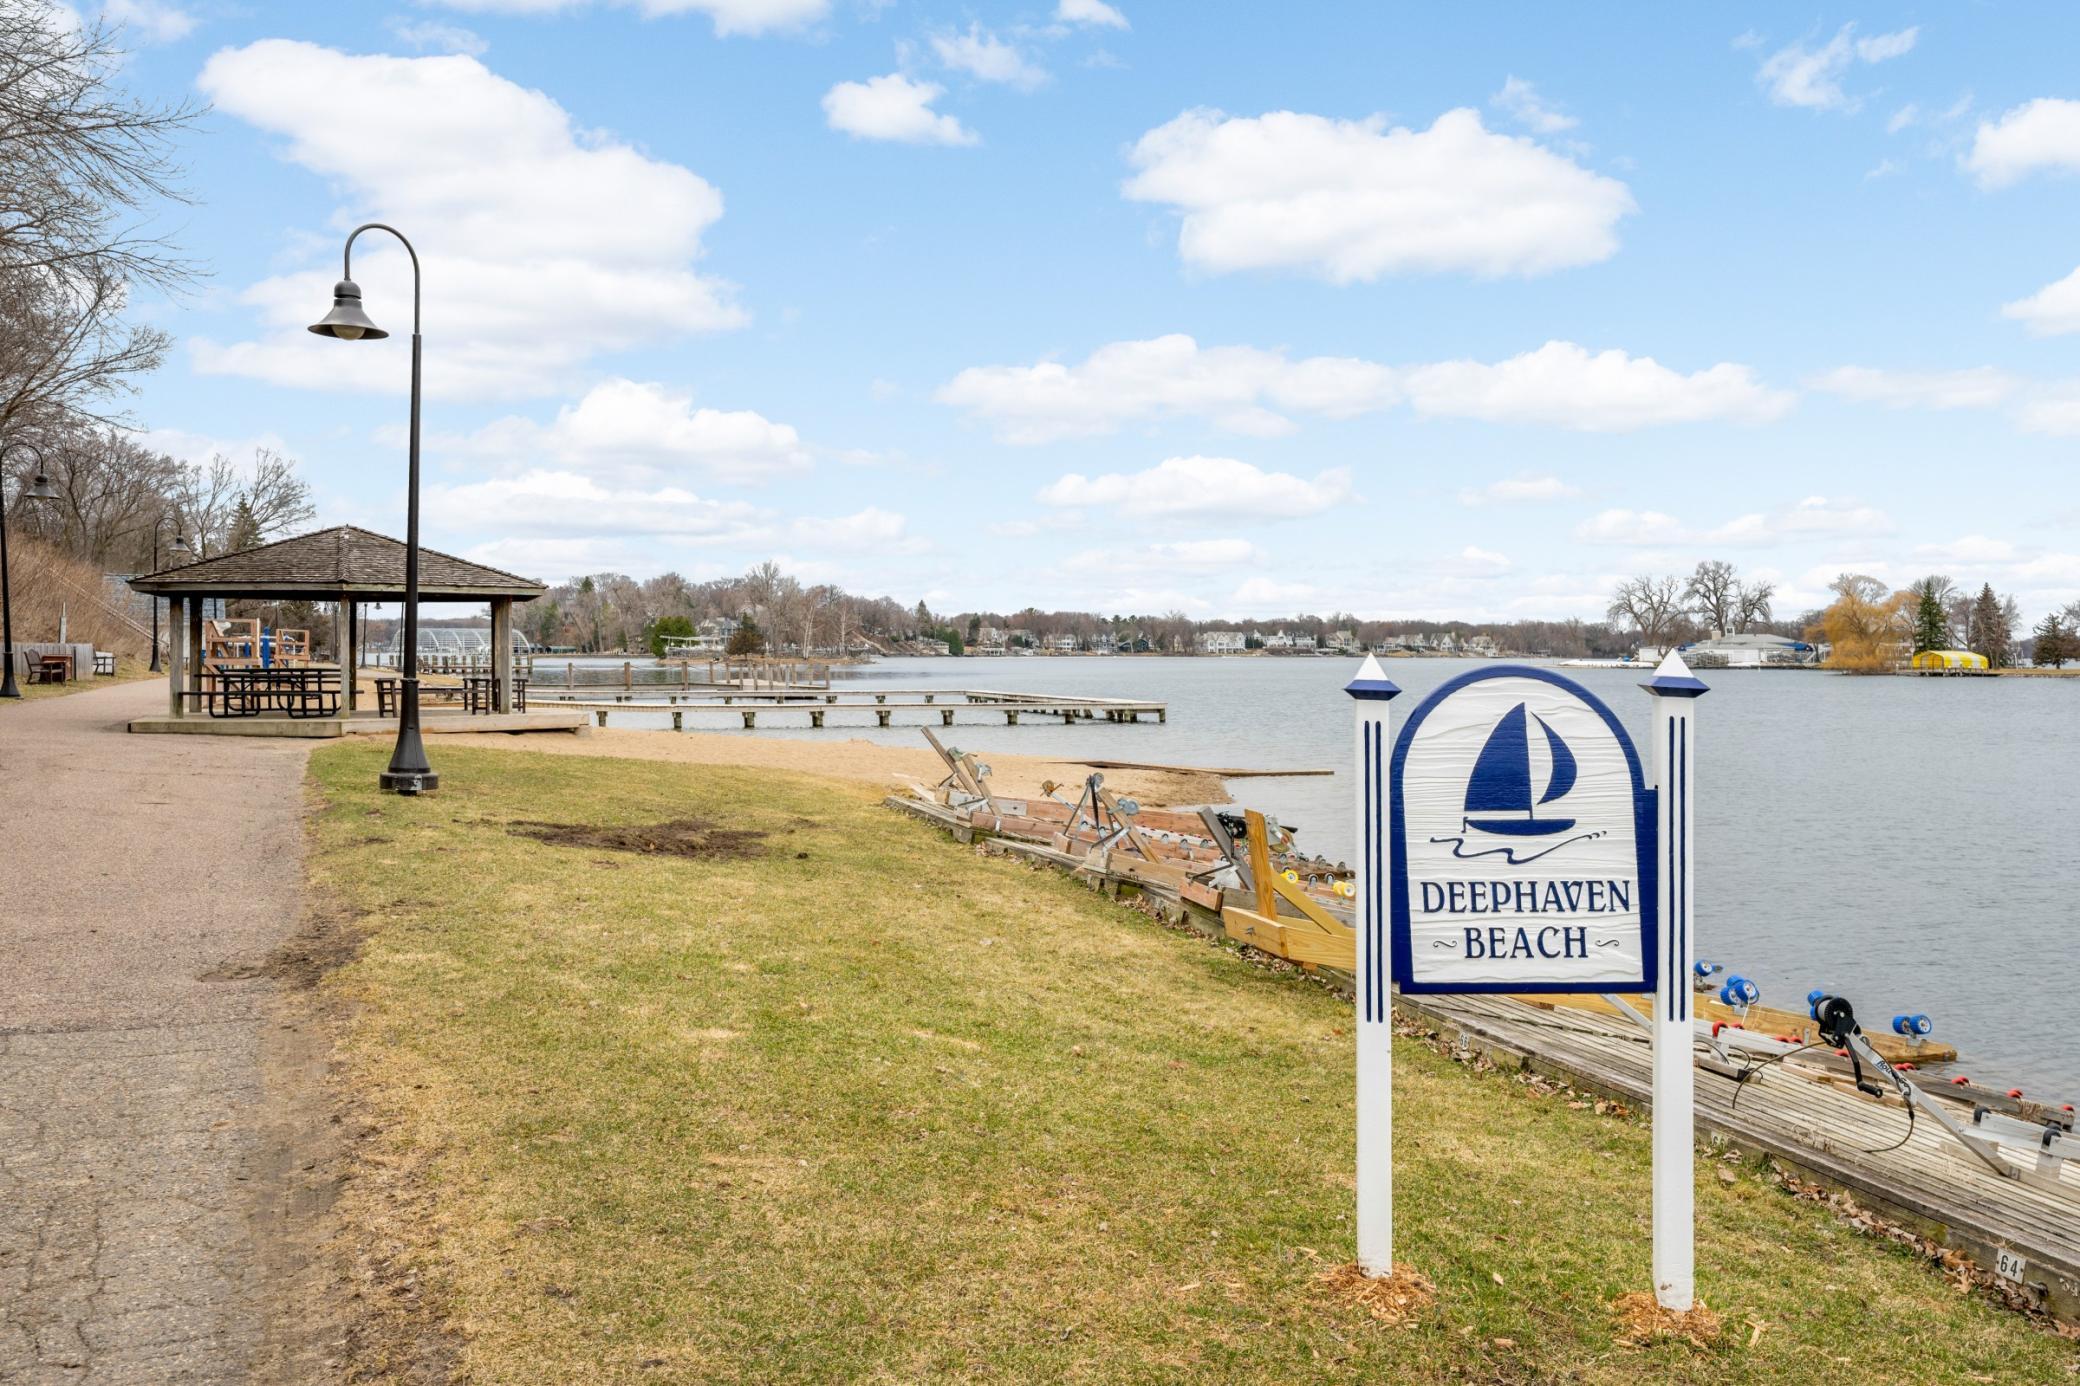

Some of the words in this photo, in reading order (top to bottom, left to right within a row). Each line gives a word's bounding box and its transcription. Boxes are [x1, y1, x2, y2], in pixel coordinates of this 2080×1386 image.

[1420, 880, 1630, 913] DEEPHAVEN
[1463, 926, 1589, 959] BEACH
[2000, 1255, 2018, 1277] 64
